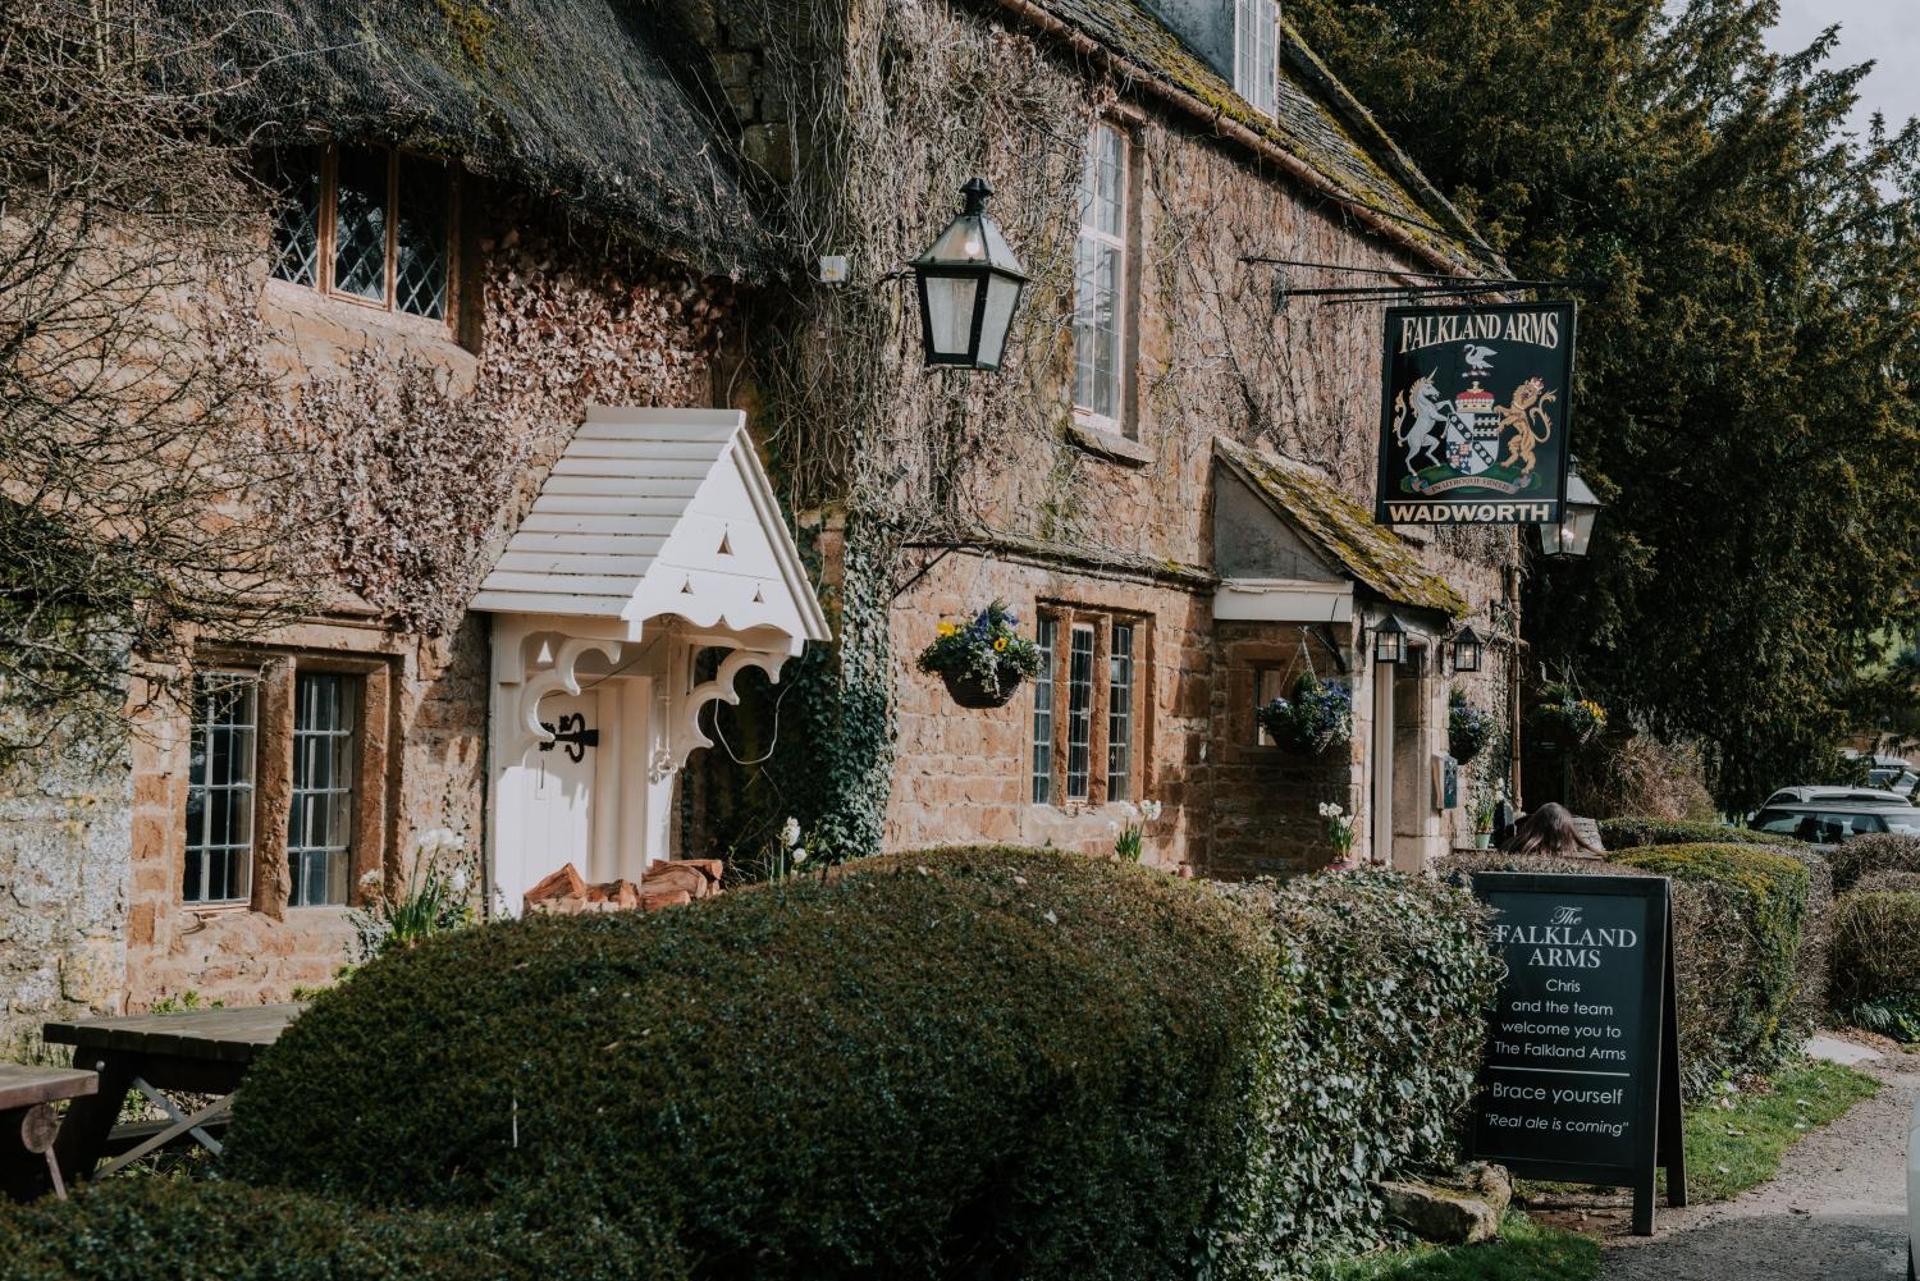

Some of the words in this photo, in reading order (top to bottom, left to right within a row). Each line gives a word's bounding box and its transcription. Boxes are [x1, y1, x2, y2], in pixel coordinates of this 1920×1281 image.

[1399, 314, 1501, 354] FALKLAND
[1503, 312, 1559, 349] ARMS
[1389, 503, 1549, 522] WADWORTH
[1550, 905, 1583, 925] The
[1495, 925, 1637, 948] FALKLAND
[1528, 948, 1601, 968] ARMS
[1545, 979, 1581, 992] Chris
[1511, 1000, 1541, 1012] and
[1545, 1001, 1569, 1014] the
[1574, 1002, 1614, 1016] team
[1501, 1020, 1570, 1035] welcome
[1574, 1027, 1602, 1038] you
[1606, 1026, 1622, 1038] to
[1494, 1041, 1520, 1055] The
[1523, 1042, 1586, 1058] Falkland
[1589, 1047, 1627, 1061] Arms
[1493, 1082, 1546, 1100] Brace
[1551, 1088, 1623, 1105] yourself
[1485, 1113, 1523, 1127] "Real
[1525, 1116, 1549, 1130] ale
[1551, 1117, 1562, 1131] is
[1565, 1120, 1629, 1137] coming"
